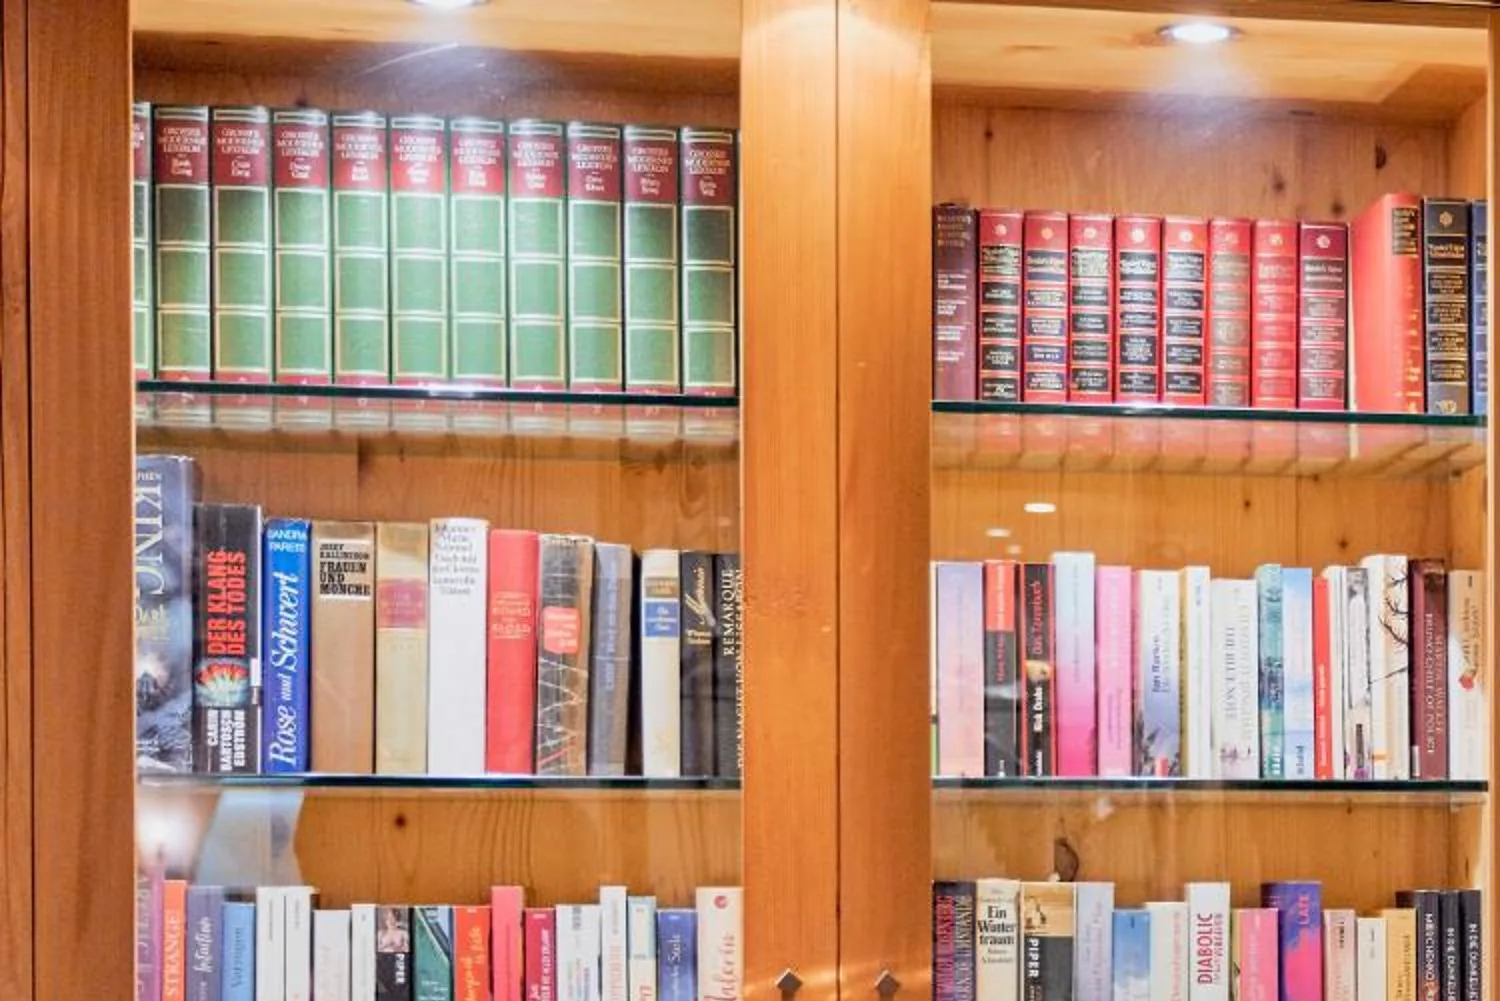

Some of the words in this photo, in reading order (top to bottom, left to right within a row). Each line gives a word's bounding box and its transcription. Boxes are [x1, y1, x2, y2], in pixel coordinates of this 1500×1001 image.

[136, 484, 164, 596] KING
[319, 561, 368, 575] FRAUEN
[207, 549, 227, 614] KLANG
[227, 550, 245, 614] TODES
[319, 573, 346, 585] UND
[207, 618, 225, 656] DER
[227, 619, 245, 656] DES
[271, 571, 300, 669] Schwert
[723, 569, 737, 656] REMARQUE
[269, 705, 299, 768] Rose
[987, 905, 1007, 919] Ein
[1028, 938, 1039, 978] PIPER
[1197, 913, 1213, 984] DIABOLIC
